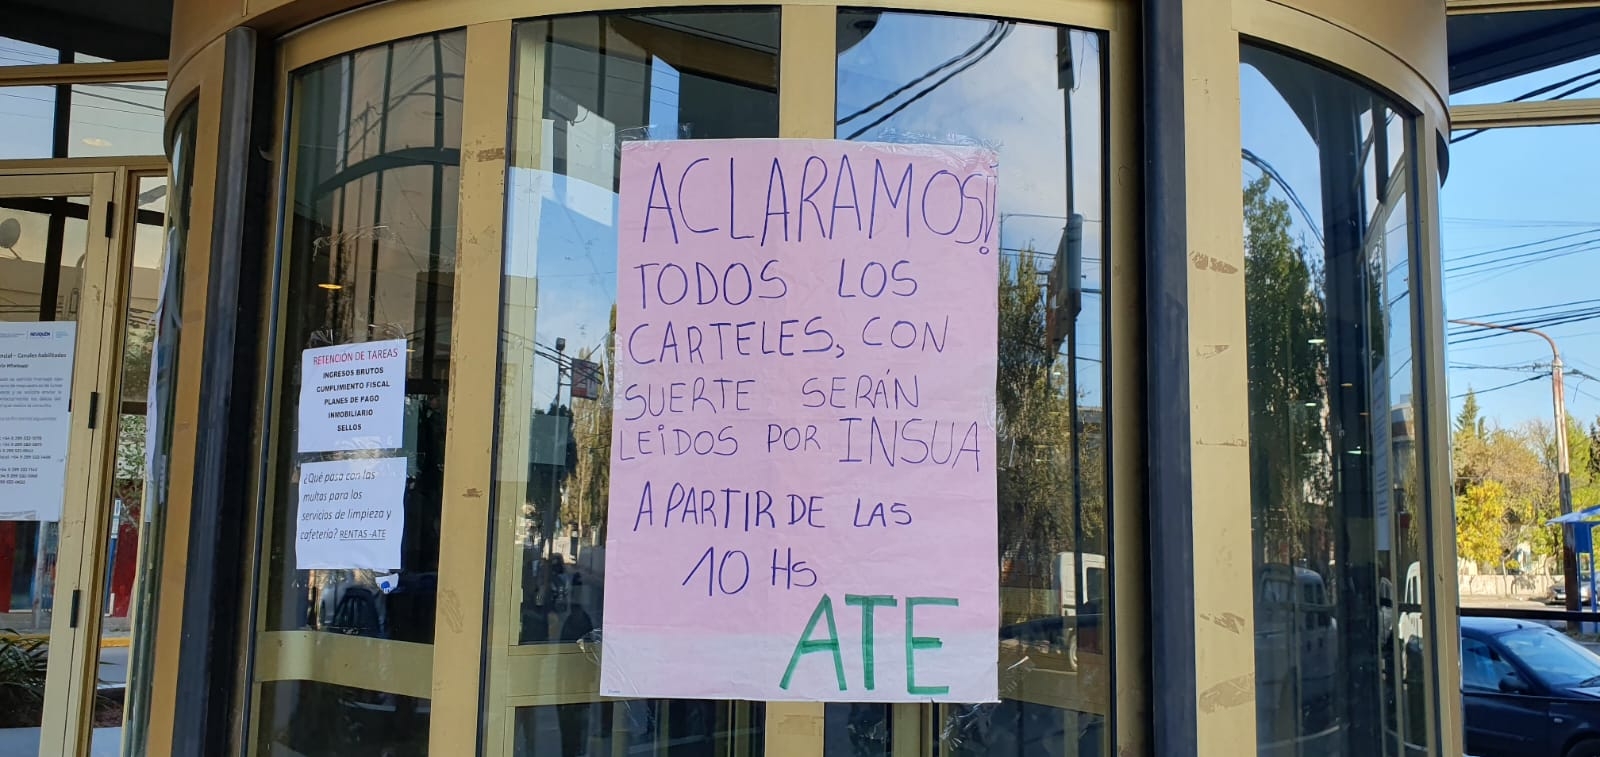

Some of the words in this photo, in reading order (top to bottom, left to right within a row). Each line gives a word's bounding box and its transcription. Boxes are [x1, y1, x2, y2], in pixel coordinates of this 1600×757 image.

[634, 259, 789, 310] TODOS
[838, 256, 919, 298] LOS
[628, 315, 846, 365] CARTELES,
[862, 315, 949, 353] CON
[313, 352, 353, 365] RETENCIÓN
[355, 350, 365, 361] DE
[367, 348, 398, 360] TAREAS
[323, 369, 355, 379] INGRESOS
[356, 367, 384, 375] BRUTOS
[316, 383, 364, 393] CUMPLIMIENTO
[366, 380, 390, 388] FISCAL
[324, 397, 348, 405] PLANES
[360, 395, 380, 403] PAGO
[624, 377, 755, 421] SUERTE
[802, 370, 919, 409] SERÁN
[328, 409, 374, 418] INMOBILIARIO
[337, 424, 362, 432] SELLOS
[767, 423, 822, 454] POR
[839, 417, 981, 472] INSUA
[303, 471, 323, 485] ¿Qué
[324, 473, 343, 485] pasa
[346, 472, 361, 481] con
[363, 468, 376, 480] las
[303, 491, 327, 502] multas
[329, 492, 348, 503] para
[350, 490, 362, 500] los
[633, 480, 653, 532] A
[664, 481, 776, 532] PARTIR
[786, 493, 826, 528] DE
[853, 497, 913, 527] LAS
[301, 510, 333, 521] servicios
[335, 509, 345, 520] de
[347, 509, 384, 521] limpieza
[386, 511, 392, 521] y
[340, 529, 368, 539] RENTAS
[682, 546, 750, 597] 10
[779, 594, 959, 695] ATE
